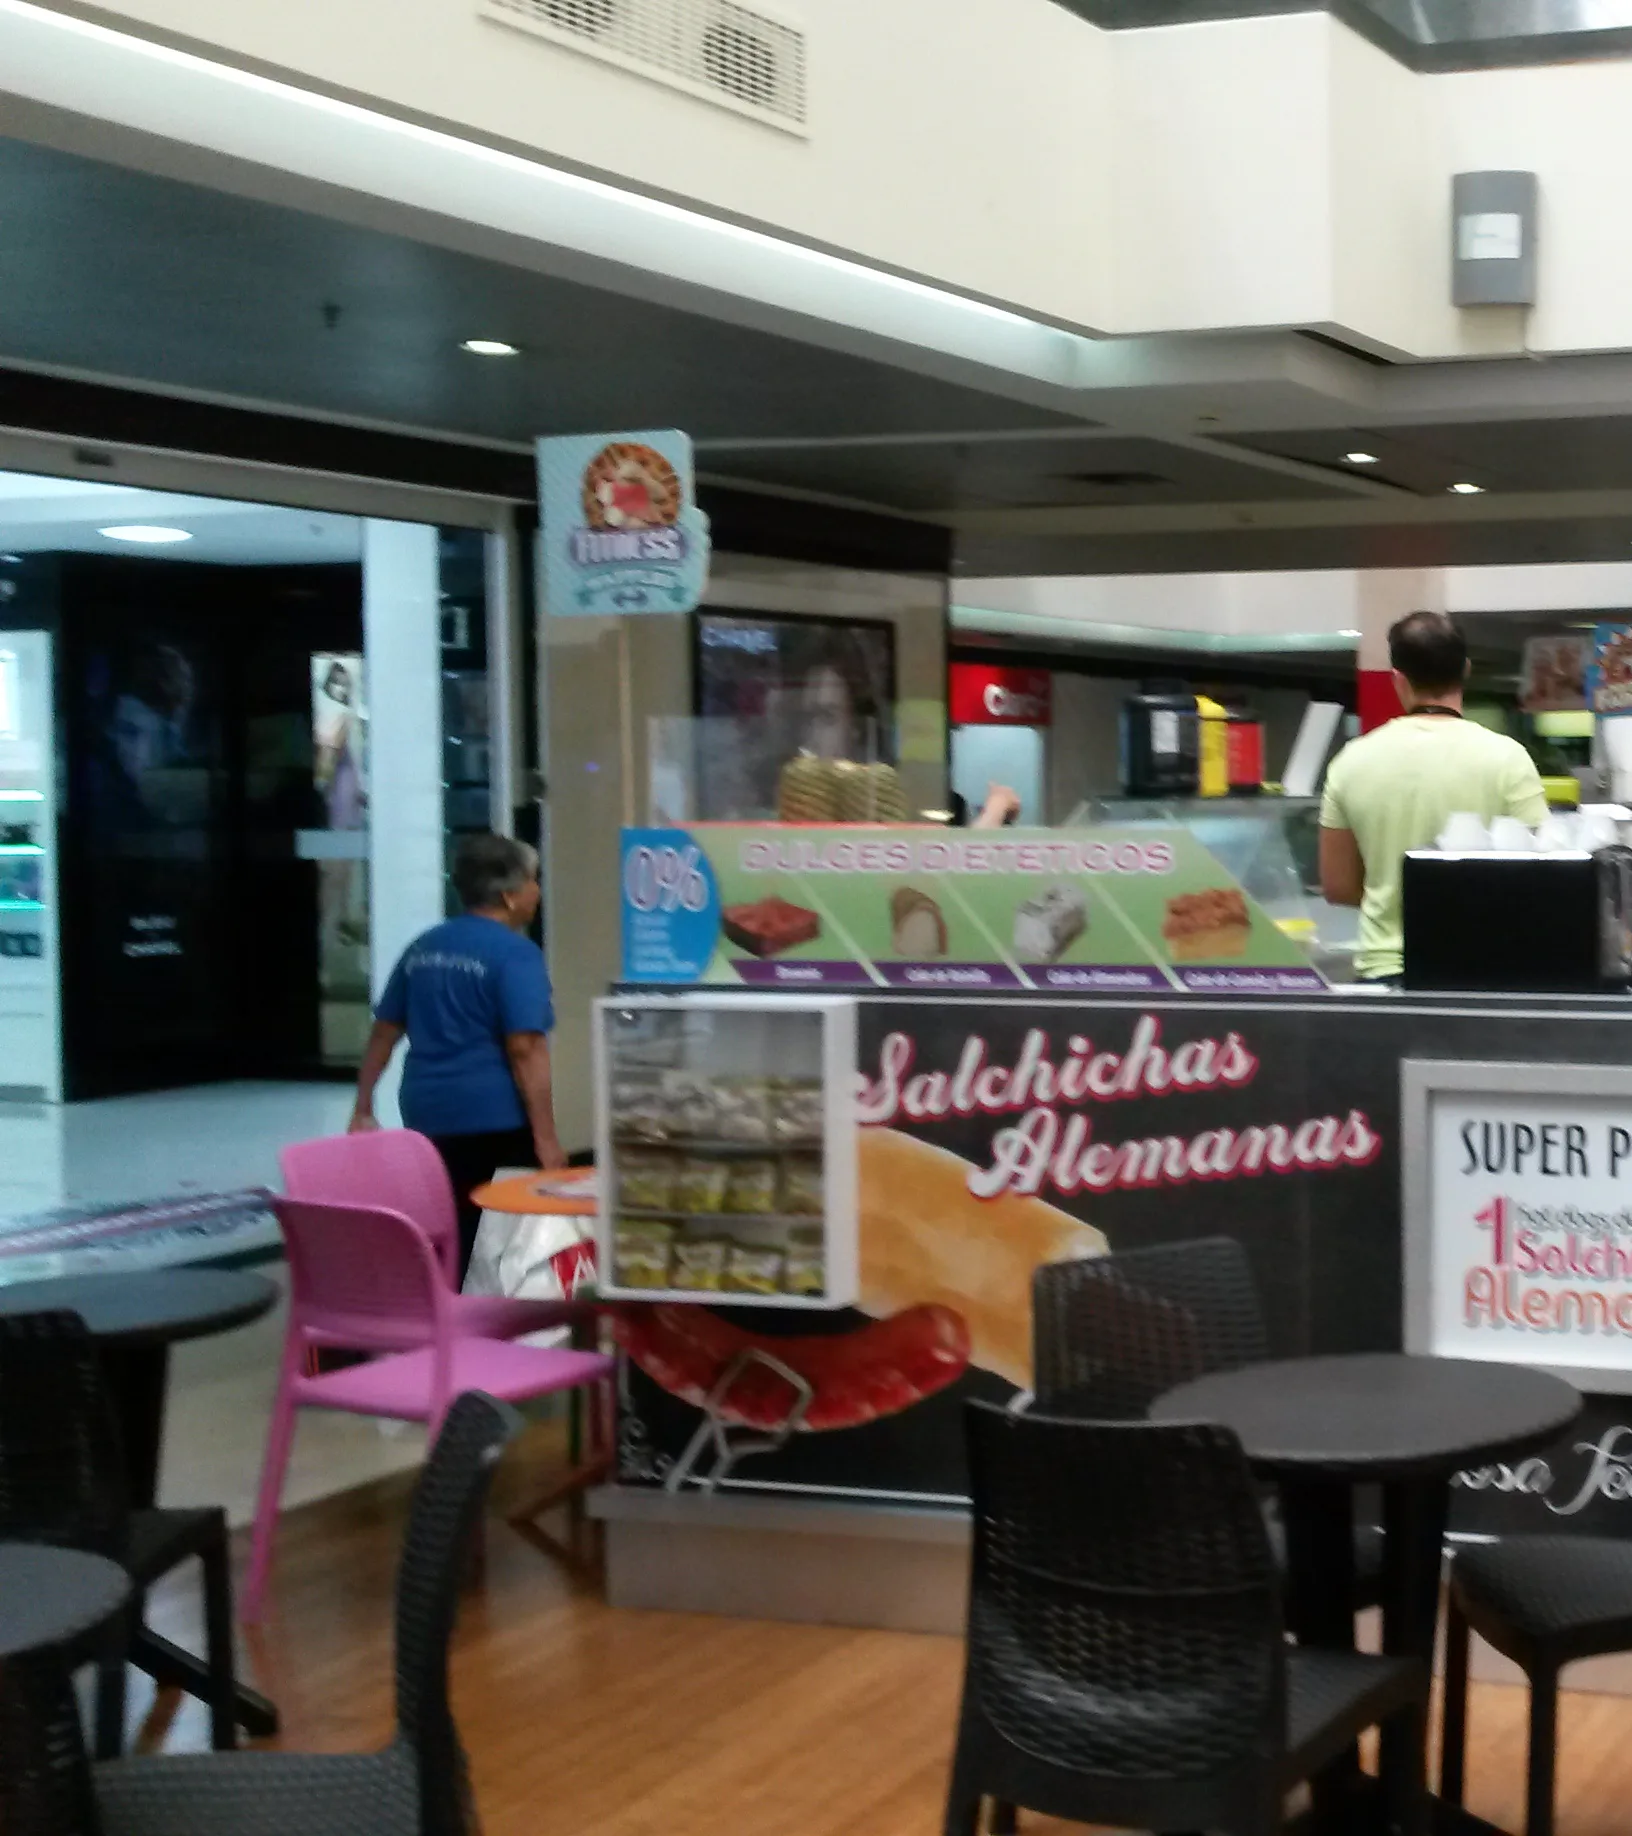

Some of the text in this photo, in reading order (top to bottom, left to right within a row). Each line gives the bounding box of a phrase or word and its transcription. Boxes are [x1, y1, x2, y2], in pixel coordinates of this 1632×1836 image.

[623, 846, 708, 913] 0%
[739, 839, 1175, 876] DULCES DIETETICOS
[855, 1013, 1261, 1127] Salchichas
[967, 1105, 1382, 1202] Alemanas
[1459, 1118, 1590, 1177] SUPER
[1474, 1196, 1506, 1267] 1
